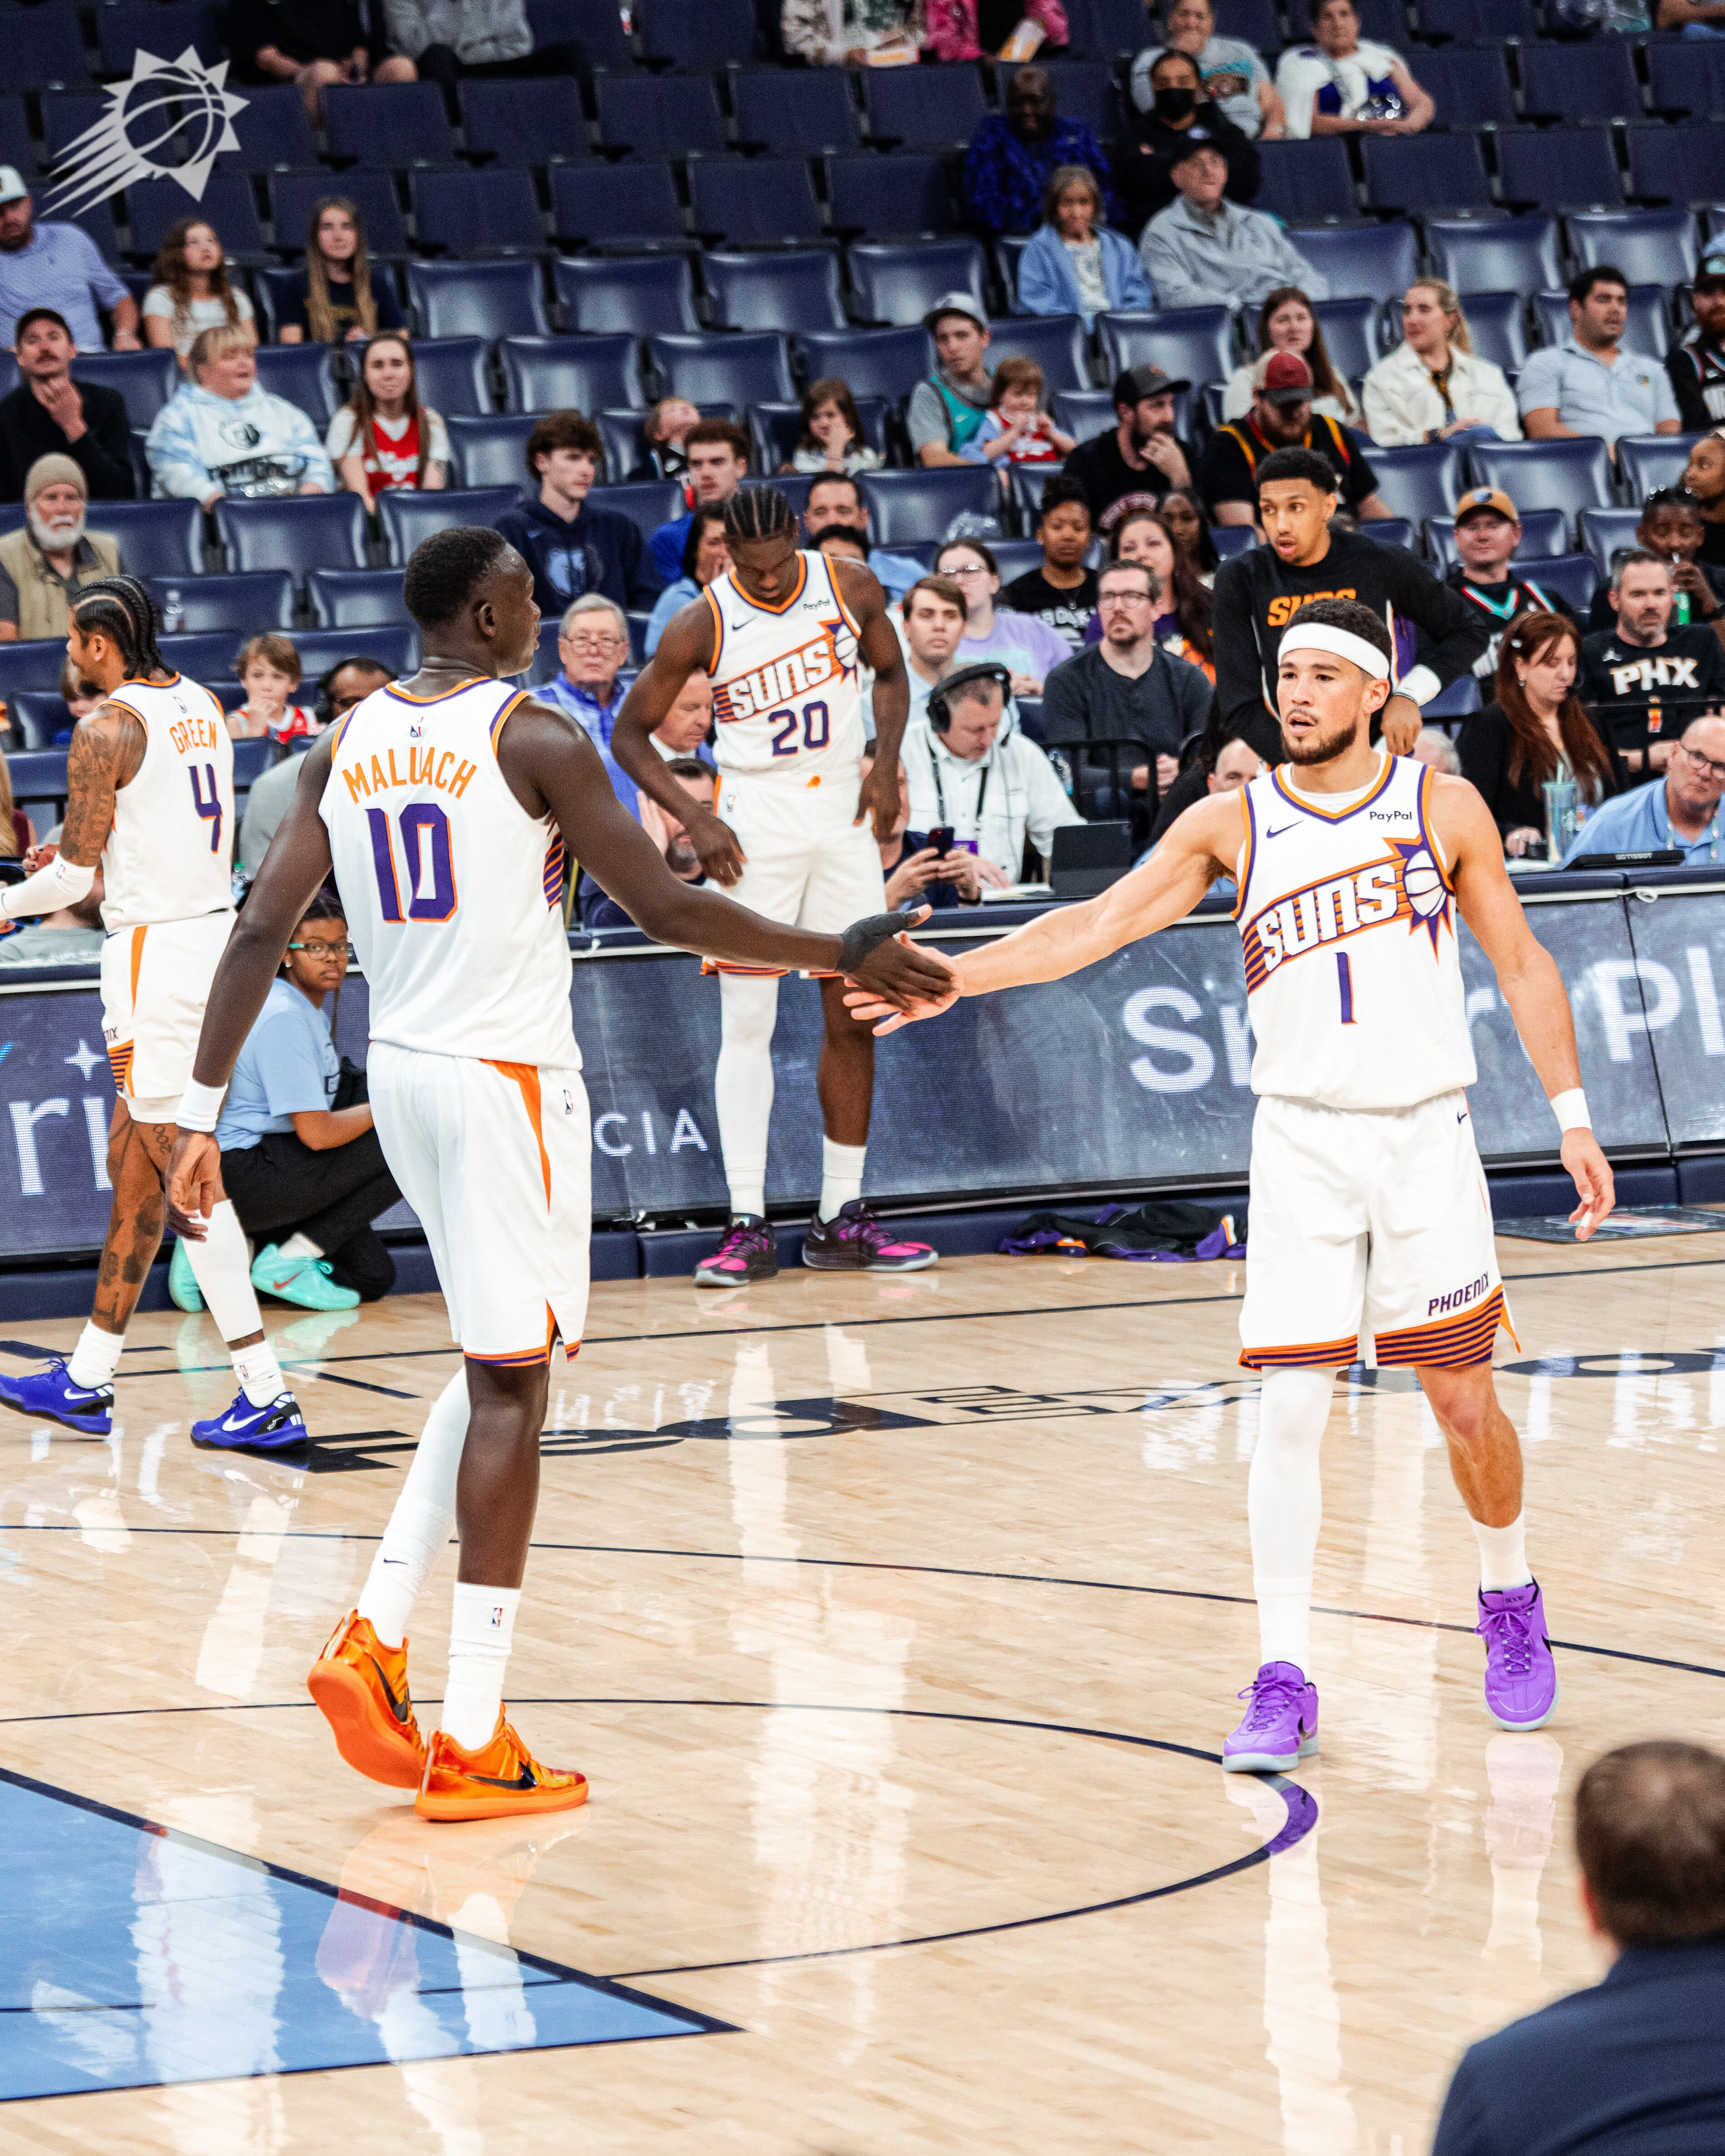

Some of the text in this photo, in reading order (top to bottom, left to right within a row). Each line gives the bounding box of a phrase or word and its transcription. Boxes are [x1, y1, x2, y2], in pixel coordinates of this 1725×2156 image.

[802, 599, 831, 612] PayPal
[727, 640, 832, 720] SUNS
[1609, 656, 1700, 695] PHX
[169, 718, 217, 755] GREEN
[768, 700, 831, 757] 20
[342, 747, 477, 804] MALUACH
[188, 763, 223, 854] 4
[1370, 811, 1412, 823] PayPal
[364, 803, 458, 923] 10
[1256, 864, 1398, 972] SUNS
[1334, 951, 1358, 1025] 1
[593, 1107, 709, 1157] CIA
[1428, 1271, 1489, 1317] PHOENIX
